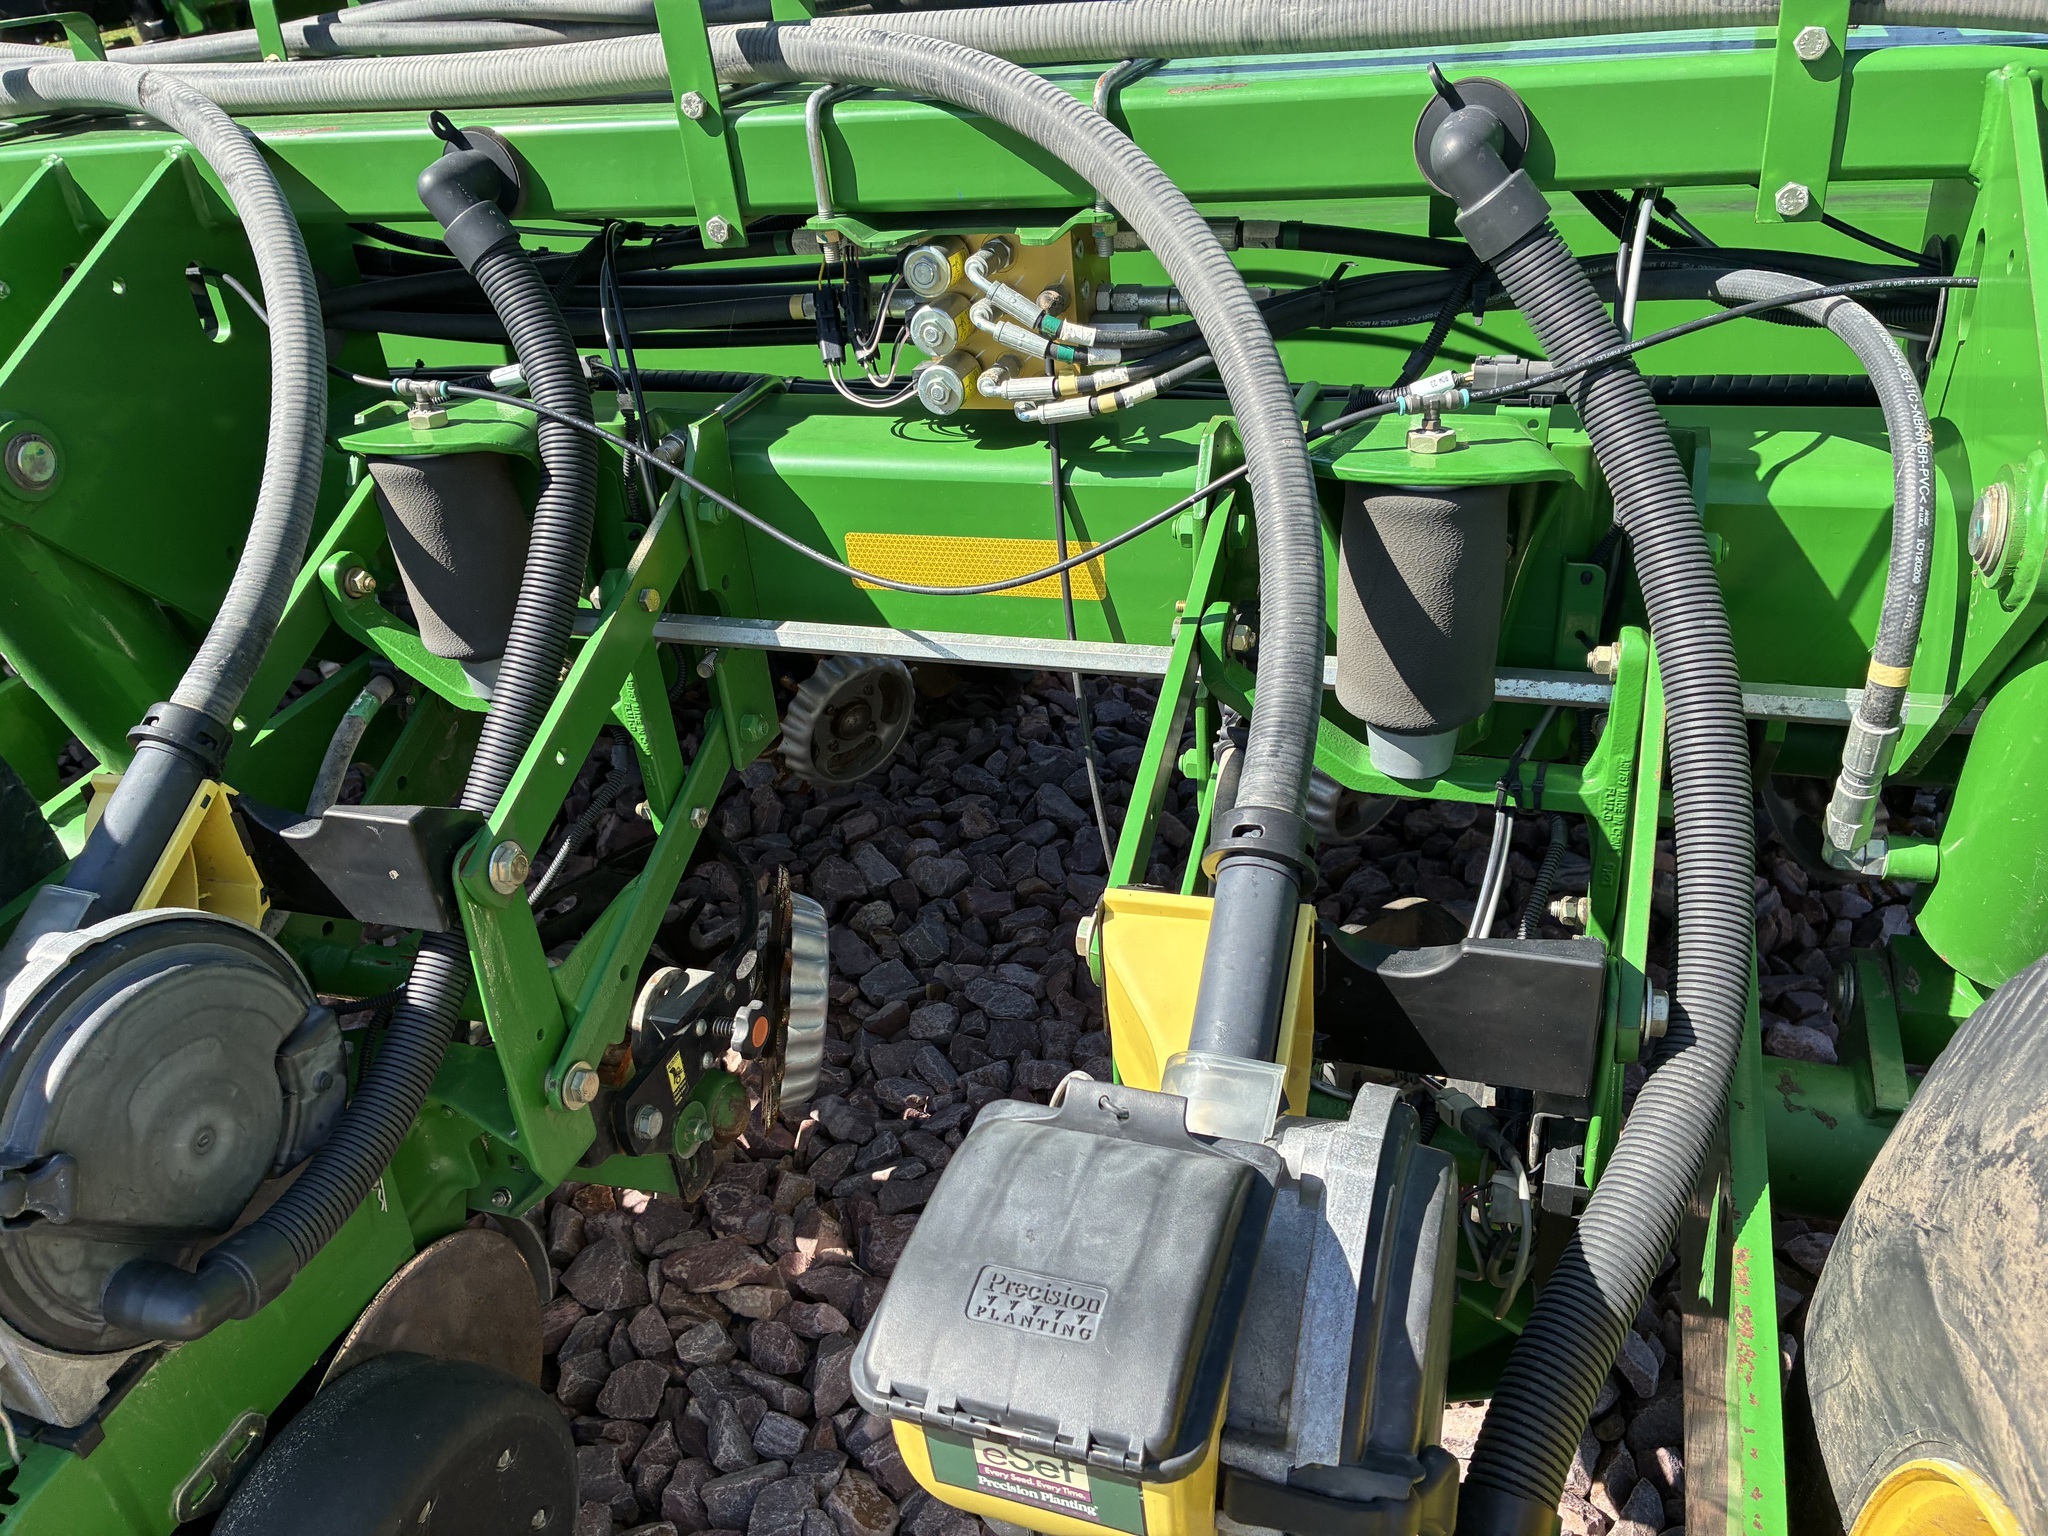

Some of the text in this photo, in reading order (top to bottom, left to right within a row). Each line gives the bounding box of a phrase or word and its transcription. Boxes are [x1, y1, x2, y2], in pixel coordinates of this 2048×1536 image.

[1898, 367, 1919, 402] 2G-11C
[1902, 594, 1918, 629] Z17473
[983, 1273, 1101, 1314] Precision
[974, 1305, 1092, 1341] PLANTING
[983, 1445, 1074, 1483] eSet
[984, 1466, 1009, 1480] Every
[1010, 1473, 1035, 1486] Seed.
[1036, 1480, 1061, 1494] Every
[977, 1475, 1097, 1517] Precision Planting
